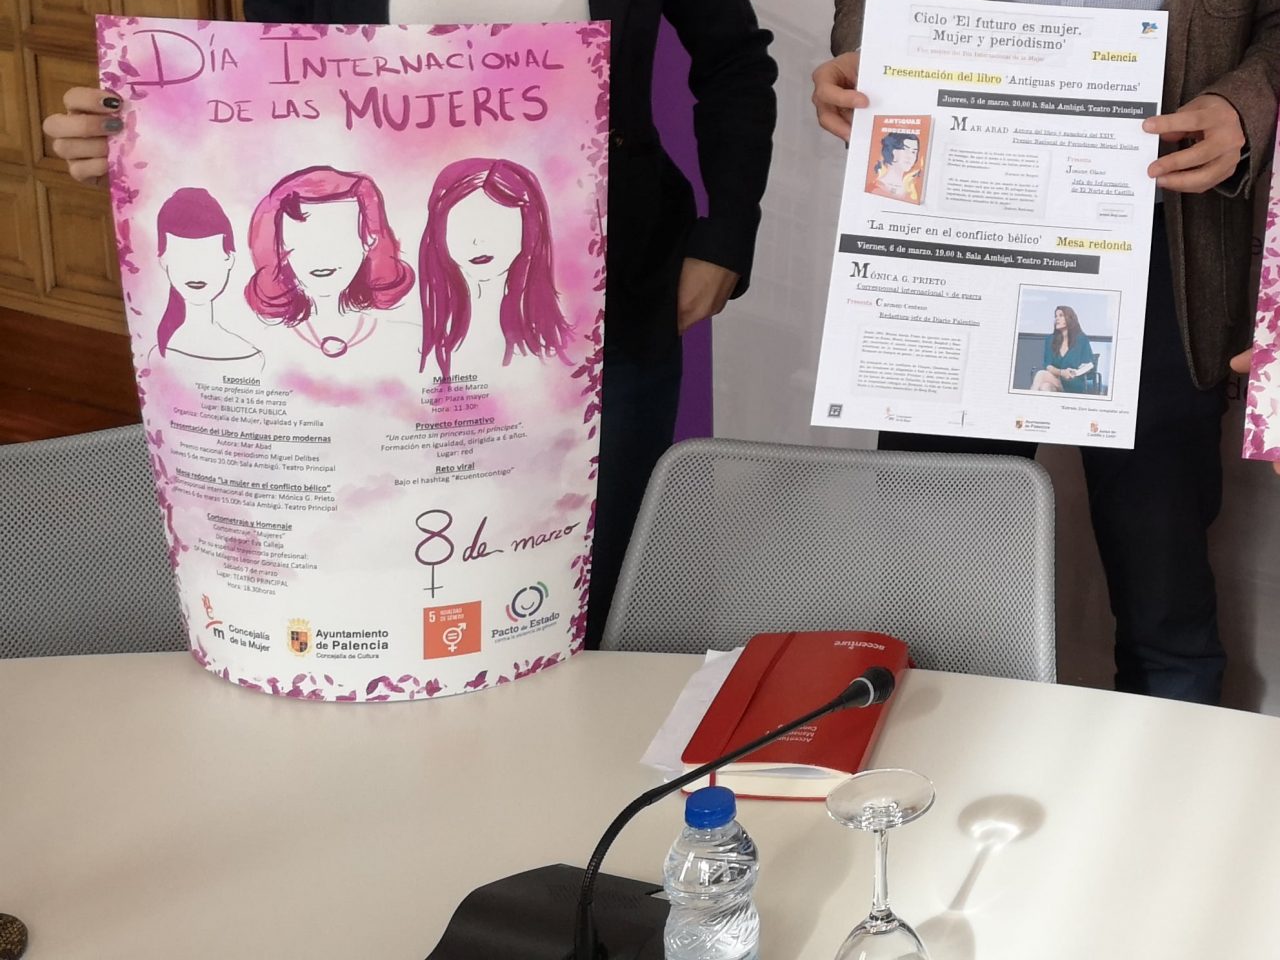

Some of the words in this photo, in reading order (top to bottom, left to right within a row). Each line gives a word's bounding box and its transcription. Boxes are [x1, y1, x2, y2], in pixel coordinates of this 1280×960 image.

[914, 12, 947, 25] Ciclo
[975, 17, 1017, 31] futuro
[1022, 23, 1035, 33] es
[1040, 24, 1082, 37] mujer.
[932, 29, 973, 45] Mujer
[977, 35, 985, 46] y
[1092, 51, 1138, 62] Palencia
[883, 65, 954, 81] Presentación
[957, 72, 973, 82] del
[976, 73, 1002, 85] libro
[1059, 80, 1083, 90] pero
[208, 100, 254, 123] DE
[271, 97, 321, 121] LAS
[339, 85, 549, 131] MUJERES
[889, 224, 920, 235] mujer
[925, 227, 938, 236] en
[942, 228, 951, 237] el
[956, 229, 1004, 242] conflicto
[1056, 236, 1084, 248] Mesa
[1088, 238, 1132, 251] redonda
[223, 376, 261, 385] Exposición
[416, 421, 452, 431] Proyecto
[454, 417, 495, 427] formativo
[209, 427, 220, 436] del
[240, 432, 271, 441] Antiguas
[273, 434, 290, 442] pero
[435, 465, 455, 474] Reto
[457, 462, 475, 471] viral
[415, 509, 454, 565] 8
[462, 516, 504, 562] de
[511, 522, 580, 552] marzo
[429, 611, 436, 622] 5
[229, 624, 270, 641] Concejalía
[491, 625, 519, 638] Pacto
[530, 612, 560, 628] Estado
[316, 629, 389, 639] Ayuntamiento
[240, 637, 247, 646] la
[249, 639, 270, 653] Mujer
[316, 641, 328, 650] de
[332, 640, 389, 651] Palencia
